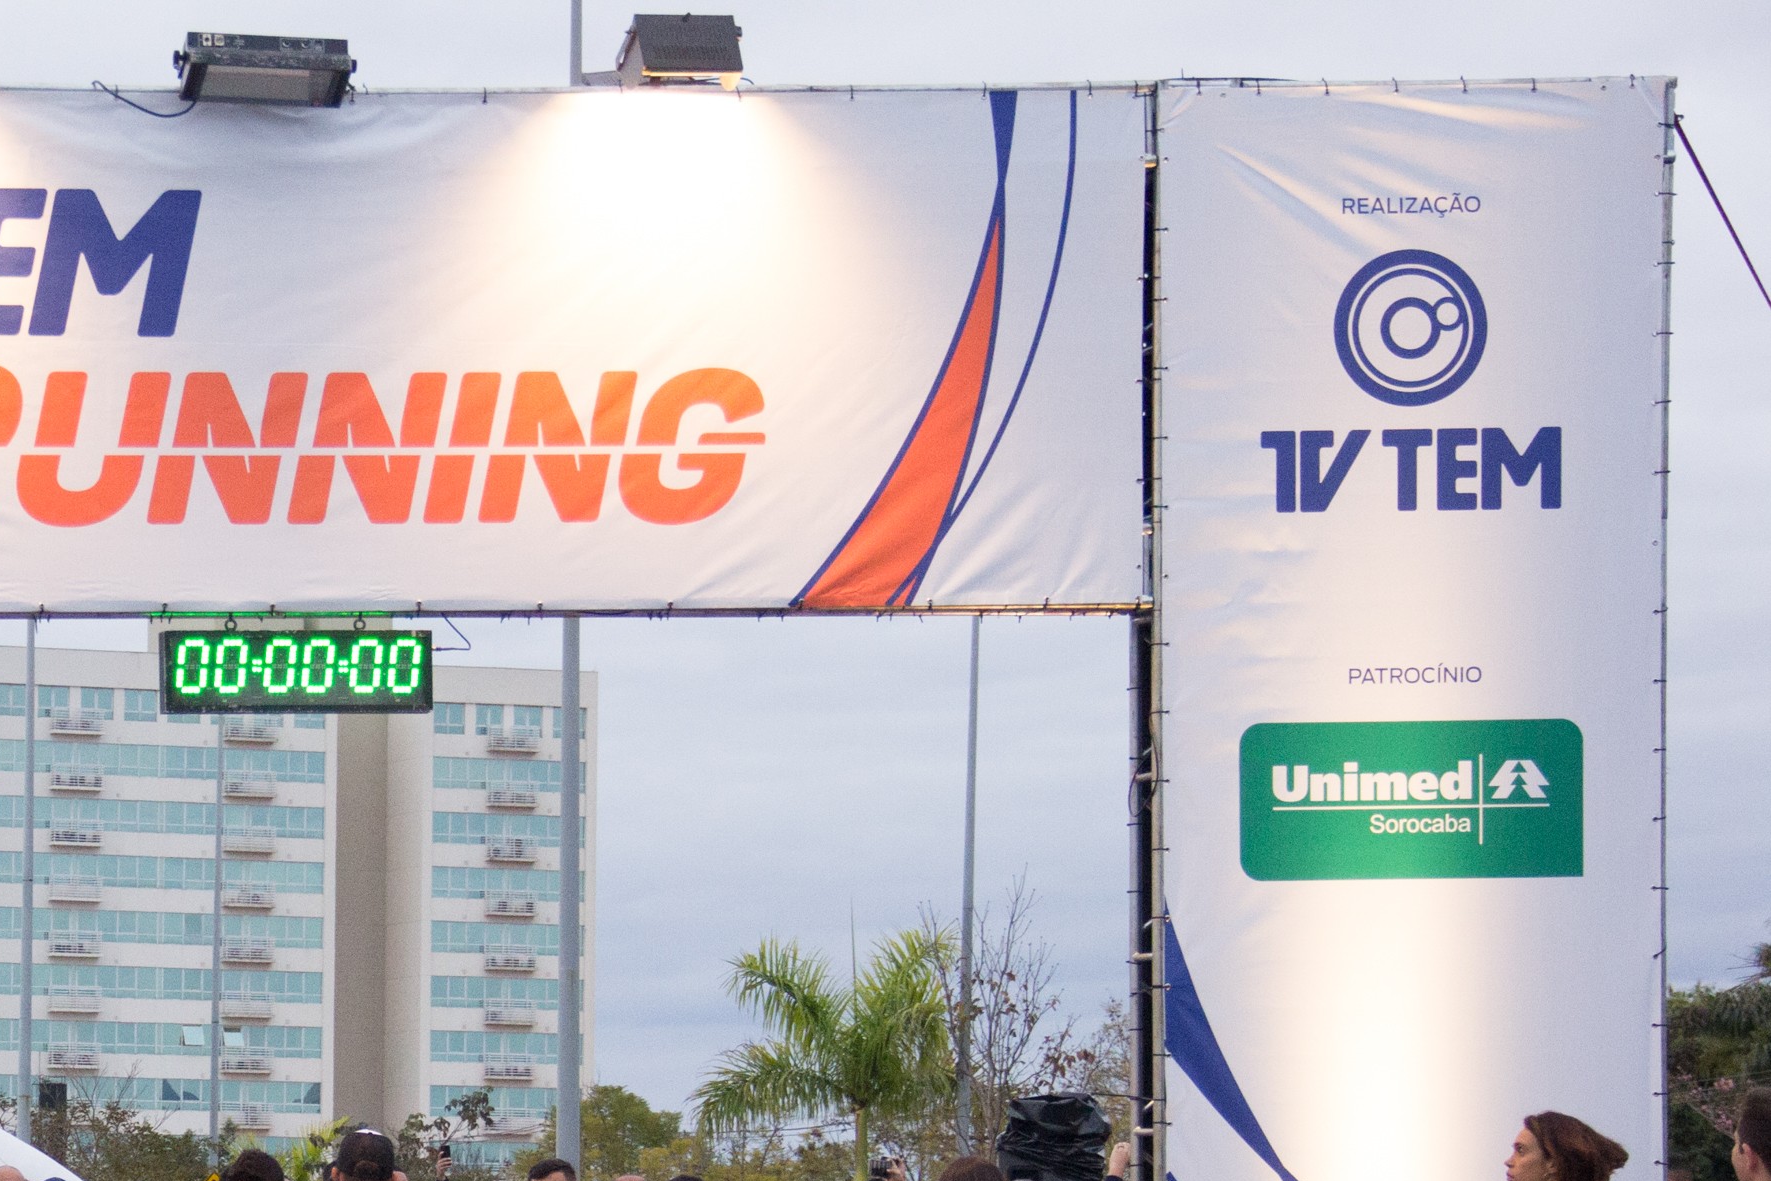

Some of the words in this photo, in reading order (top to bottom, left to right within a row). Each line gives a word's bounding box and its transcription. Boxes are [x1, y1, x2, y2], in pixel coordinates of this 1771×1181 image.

[1341, 192, 1482, 218] REALIZAÇÃO
[1259, 428, 1372, 514] TV
[1381, 425, 1564, 512] TEM
[175, 638, 423, 694] 00:00:00
[1348, 663, 1483, 684] PATROCÍNIO
[1271, 759, 1474, 804] Unimed
[1368, 812, 1472, 835] Sorocaba
